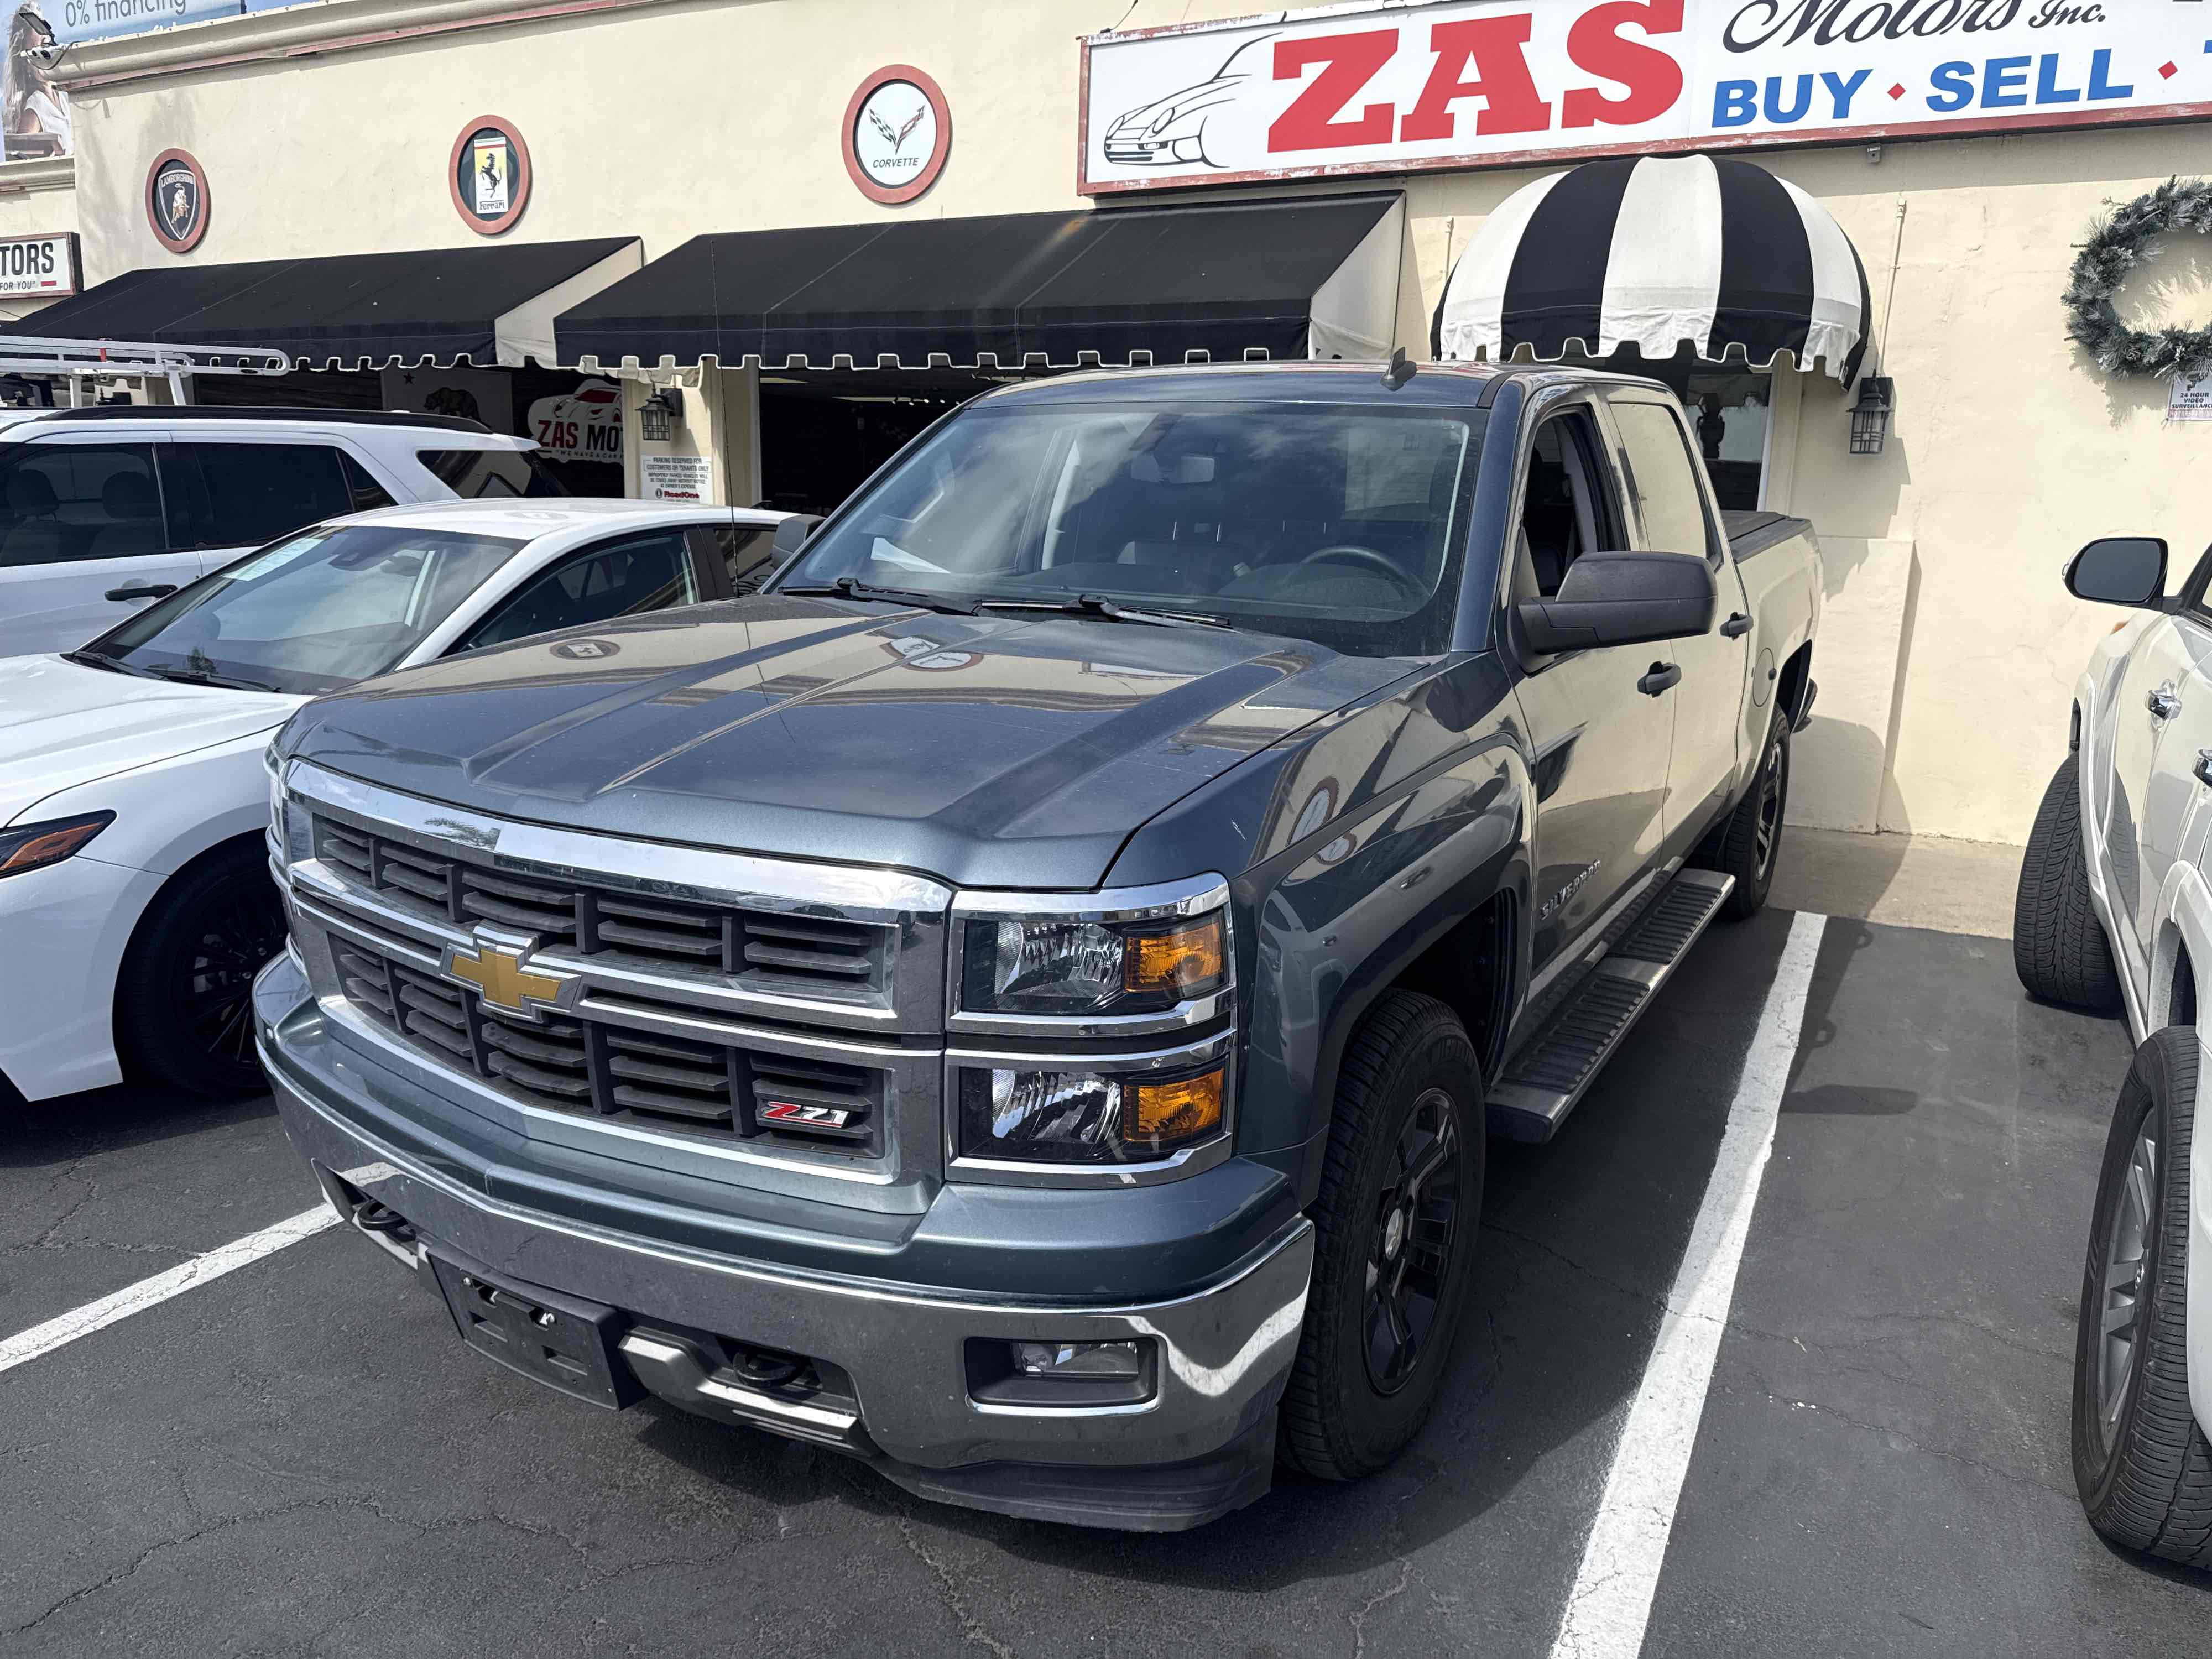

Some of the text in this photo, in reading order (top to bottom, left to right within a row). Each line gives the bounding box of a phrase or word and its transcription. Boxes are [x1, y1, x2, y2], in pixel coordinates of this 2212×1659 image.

[66, 0, 90, 27] 0%
[2028, 0, 2106, 29] Inc.
[1267, 0, 1684, 153] ZAS
[1712, 48, 2134, 128] BUY SELL
[873, 158, 919, 168] CORVETTE
[479, 200, 505, 211] Ferrari
[537, 419, 623, 452] ZAS MO
[763, 1101, 849, 1129] Z71
